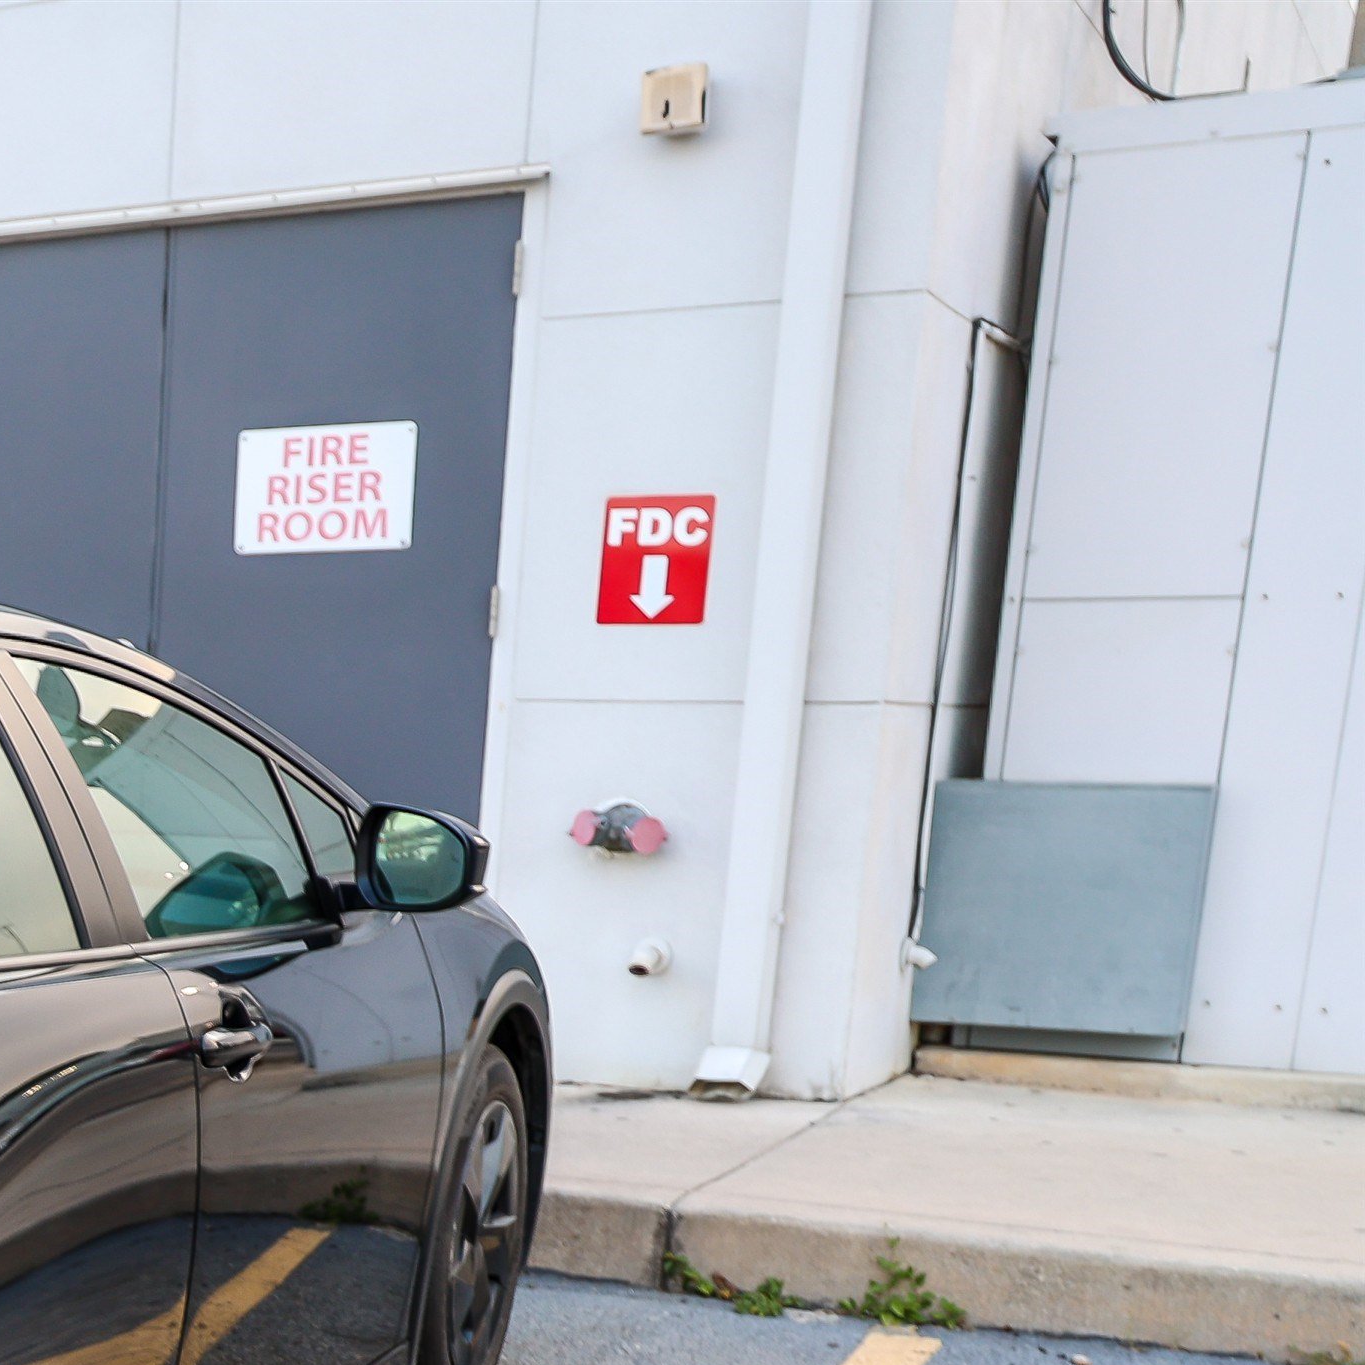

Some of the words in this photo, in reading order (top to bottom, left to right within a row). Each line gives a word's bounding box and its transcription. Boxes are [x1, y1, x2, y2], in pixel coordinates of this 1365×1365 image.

[282, 433, 370, 468] FIRE
[267, 469, 382, 506] RISER
[257, 508, 388, 543] ROOM
[606, 505, 711, 547] FDC
